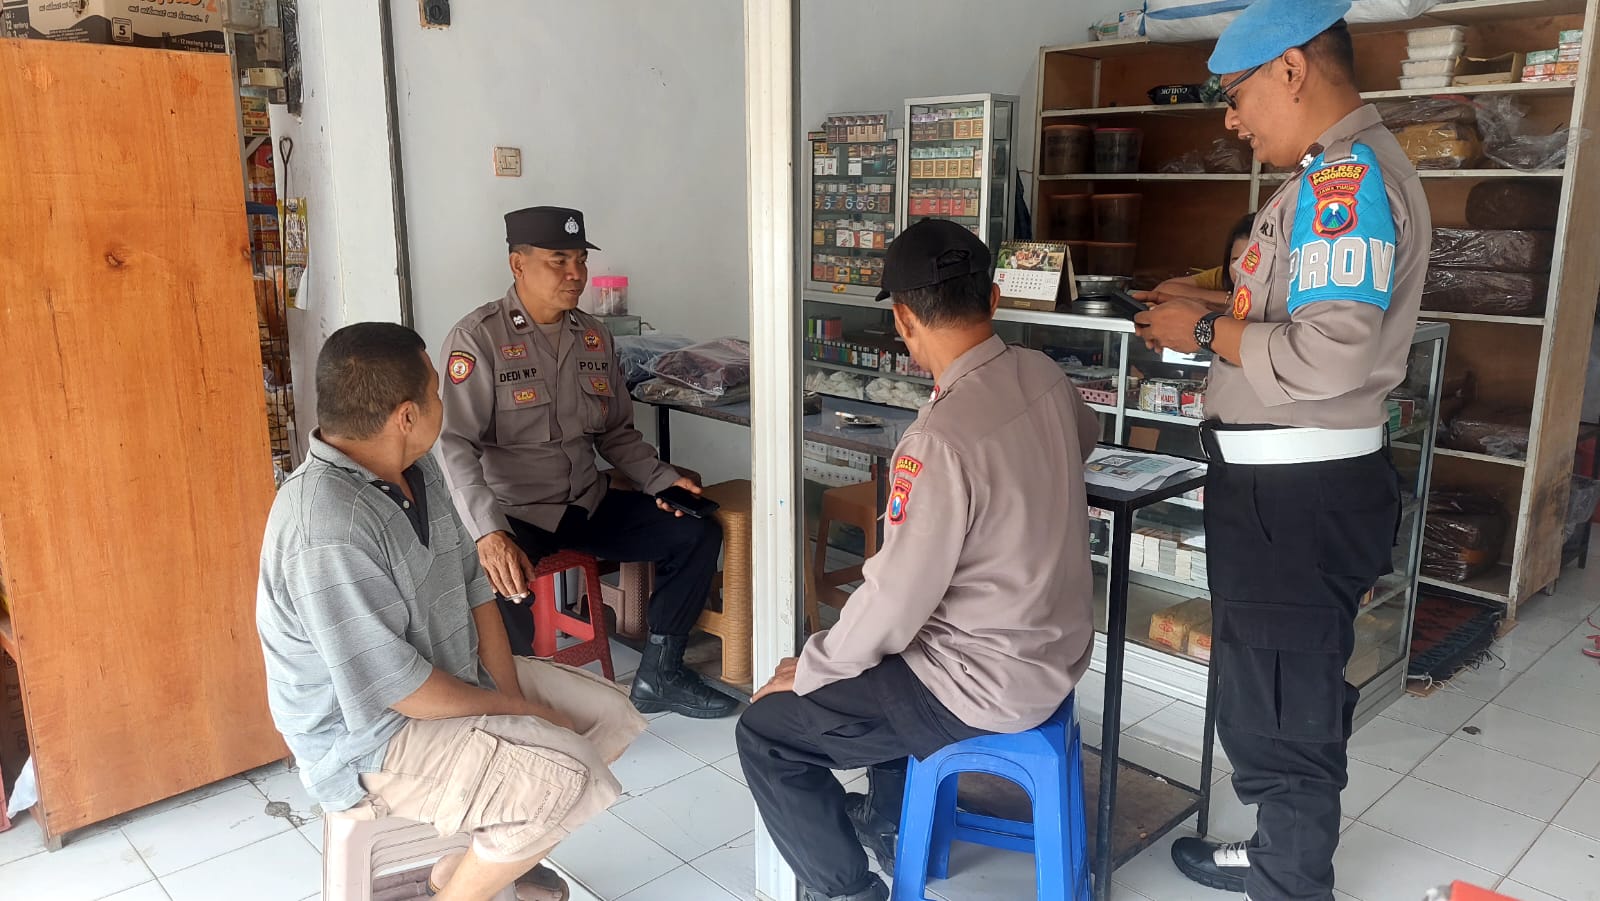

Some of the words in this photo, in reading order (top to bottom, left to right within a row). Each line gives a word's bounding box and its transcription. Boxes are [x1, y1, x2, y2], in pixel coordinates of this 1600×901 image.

[118, 25, 127, 36] 5
[1312, 165, 1363, 180] POLRES
[1313, 171, 1360, 186] PONOROGO
[499, 371, 521, 383] DEDI
